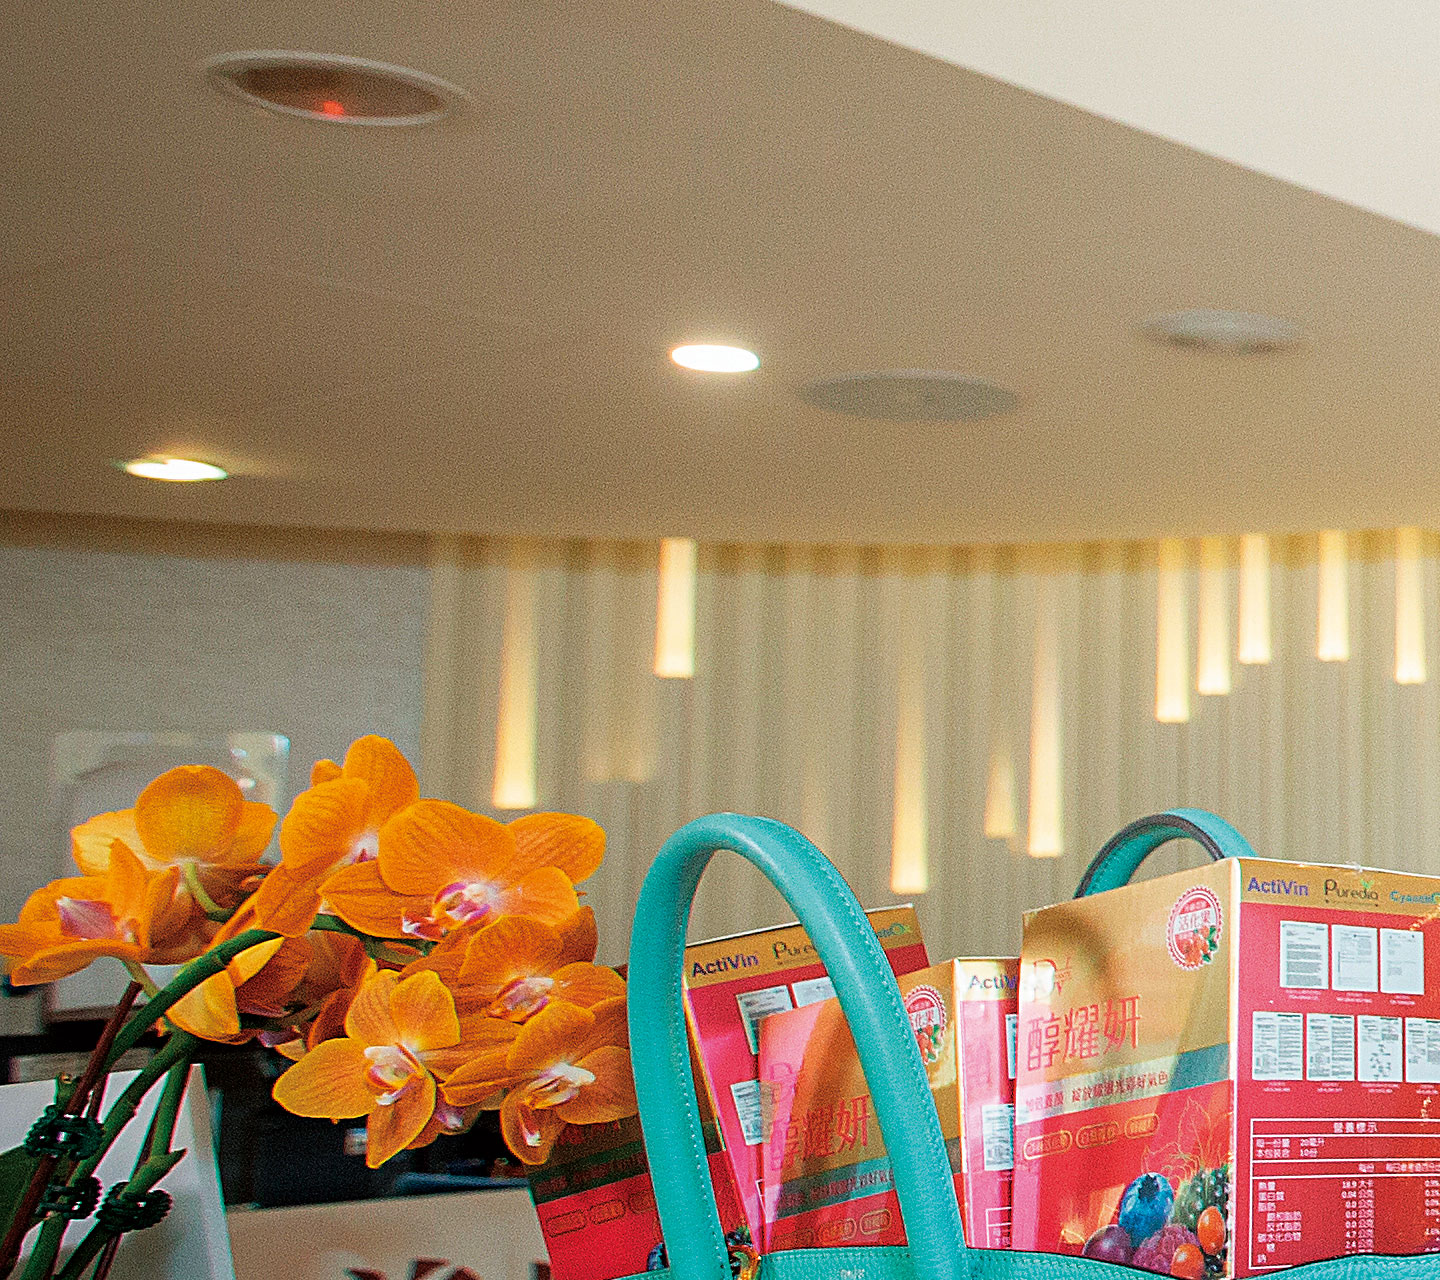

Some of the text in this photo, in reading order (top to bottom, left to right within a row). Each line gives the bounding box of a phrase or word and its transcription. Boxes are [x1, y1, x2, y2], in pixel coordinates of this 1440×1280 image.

[1248, 877, 1380, 901] ActiVin Puredia
[690, 949, 760, 979] ActiVin
[1027, 994, 1141, 1071] 醇耀妍
